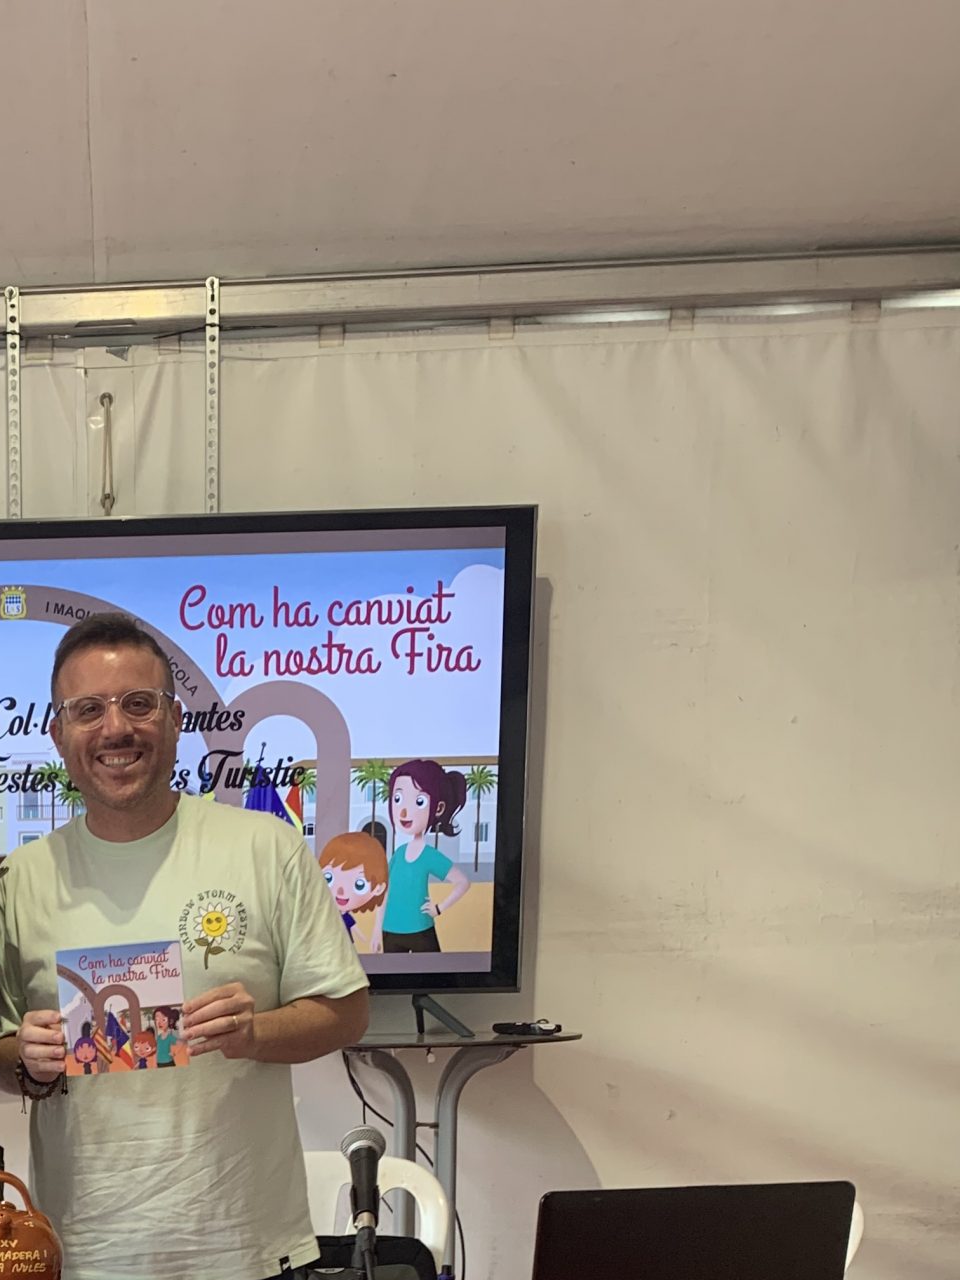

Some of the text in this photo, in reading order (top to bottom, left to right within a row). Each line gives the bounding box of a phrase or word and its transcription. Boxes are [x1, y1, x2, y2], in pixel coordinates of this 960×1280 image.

[179, 580, 455, 631] Com ha canviat
[215, 626, 482, 678] la nostra Fira
[78, 949, 171, 971] Com ha canviat
[92, 970, 105, 985] la
[108, 967, 148, 983] nostra
[149, 963, 181, 980] Fira
